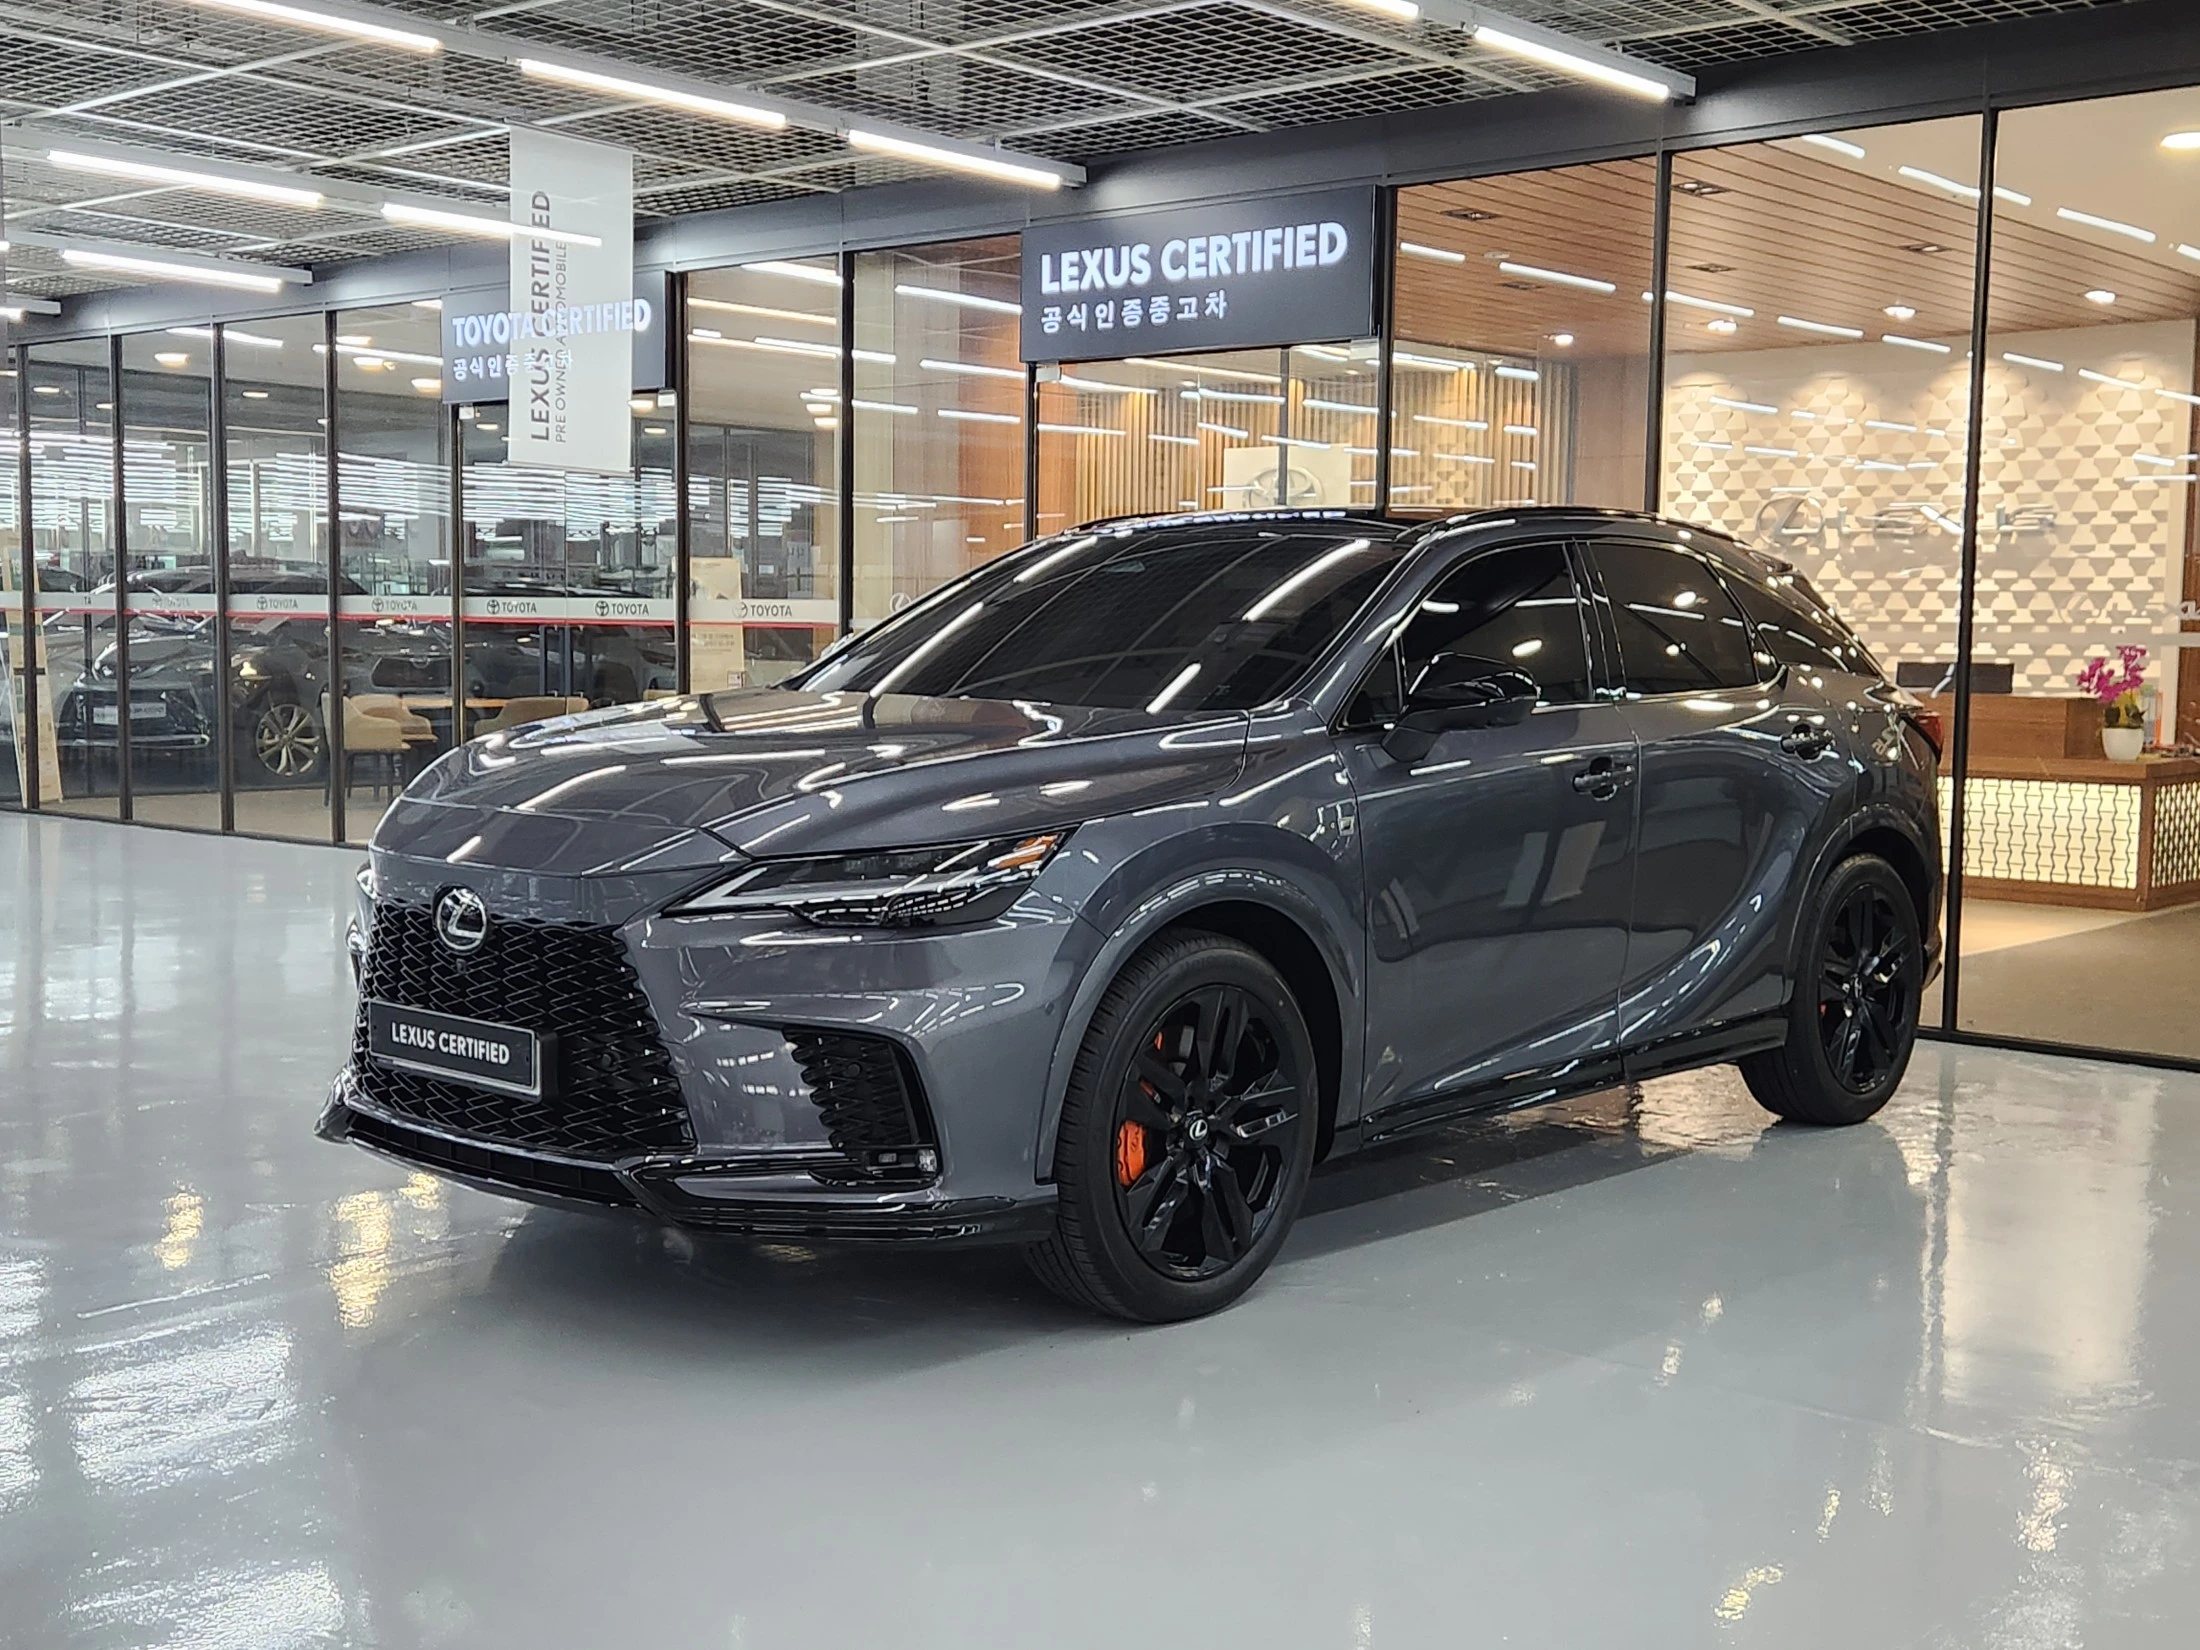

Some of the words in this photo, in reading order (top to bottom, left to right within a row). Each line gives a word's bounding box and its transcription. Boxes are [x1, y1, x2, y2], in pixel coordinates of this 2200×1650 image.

[530, 190, 550, 337] CERTIFED
[1041, 243, 1152, 295] LEXUS
[1160, 220, 1349, 281] CERTIFIED
[1041, 289, 1229, 334] 공식인증중고차
[452, 312, 535, 348] TOYOTA
[530, 347, 550, 442] LEXUS
[555, 414, 567, 443] PRE
[268, 598, 299, 609] TOYOTA
[385, 600, 418, 612] TOYOTA
[502, 602, 537, 613] TOYOTA
[611, 602, 650, 616] TOYOTA
[750, 604, 793, 617] TOYOTA
[391, 1021, 436, 1050] LEXUS
[438, 1031, 510, 1065] CERTIFIED
